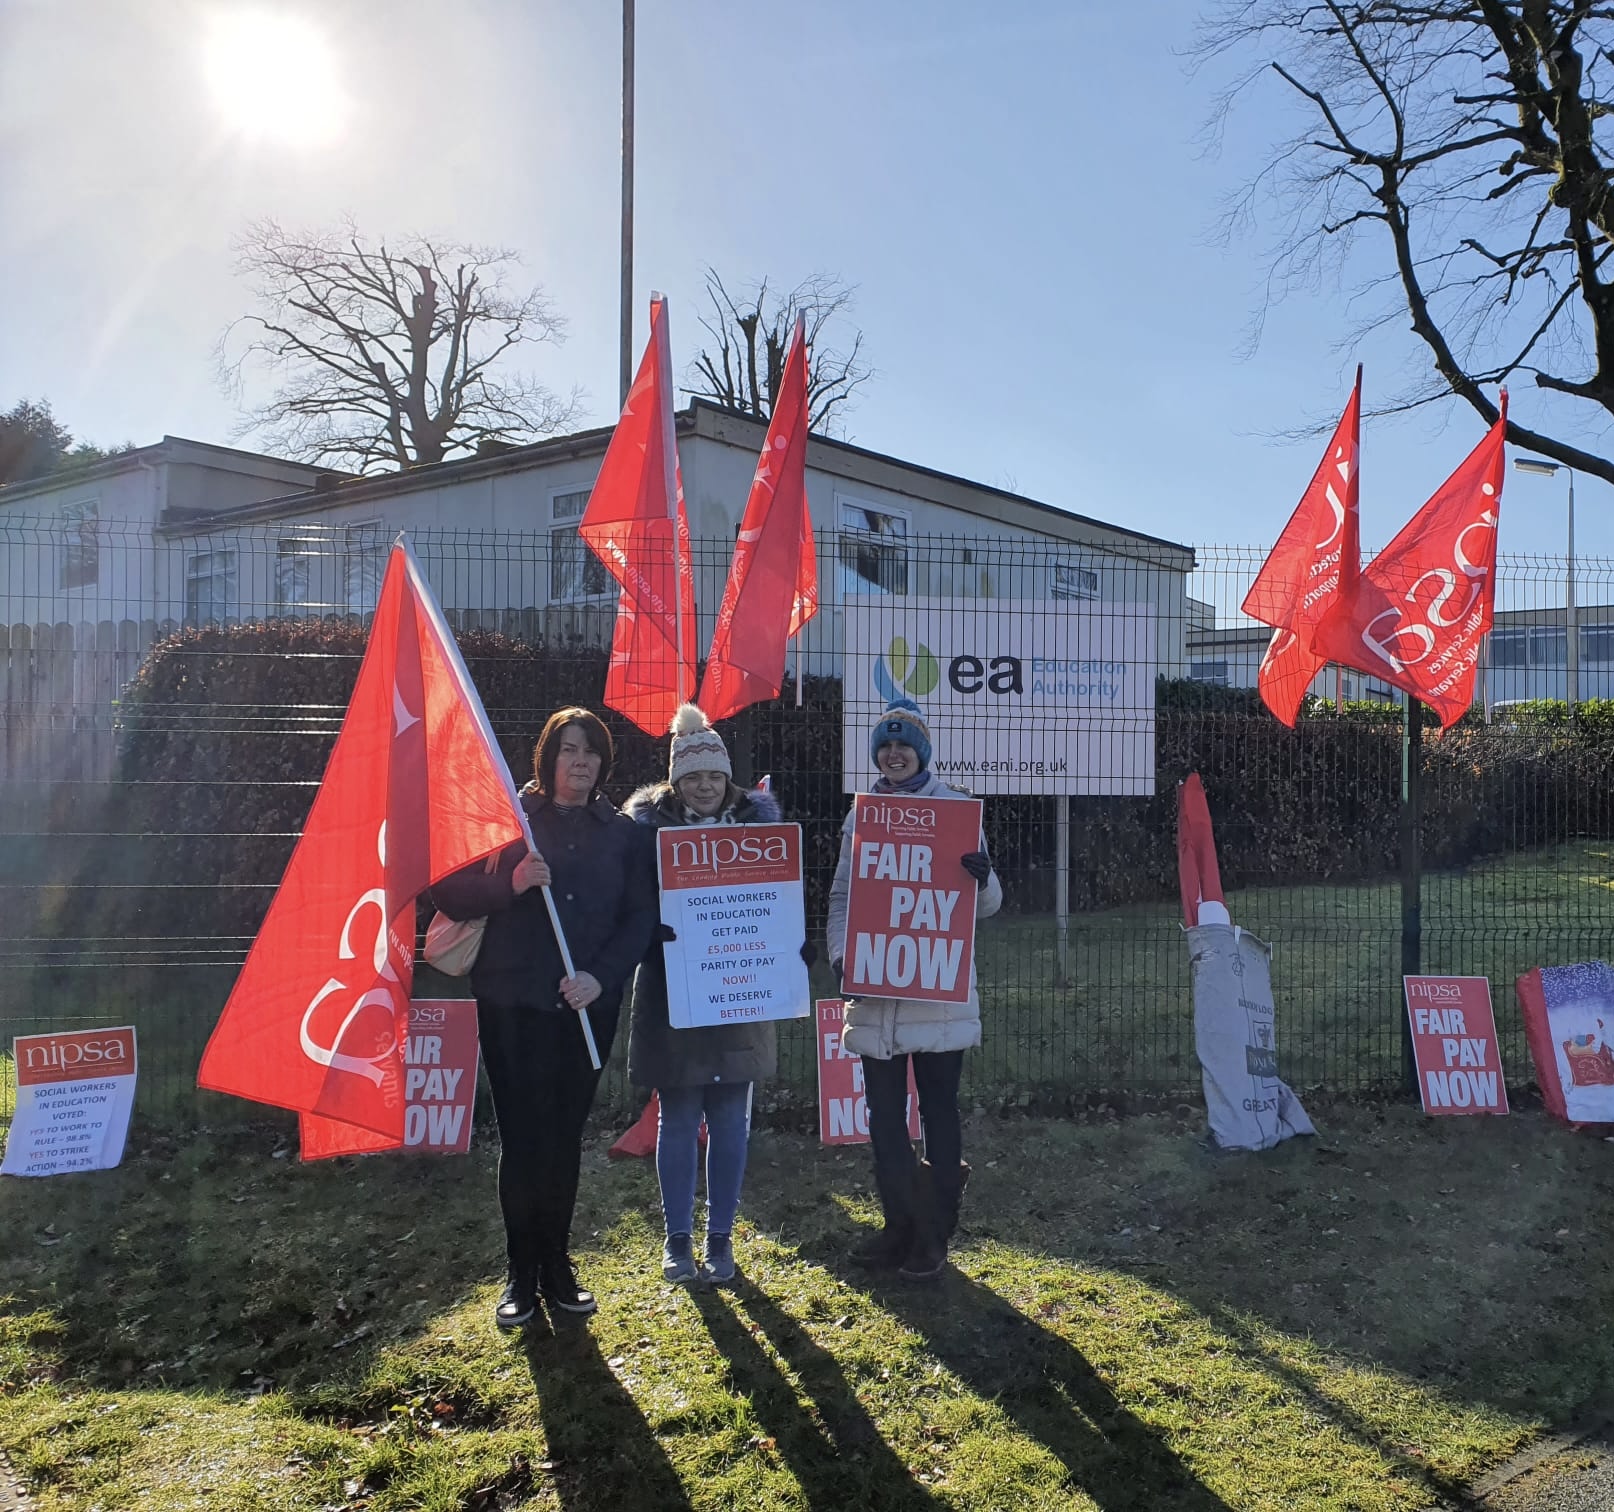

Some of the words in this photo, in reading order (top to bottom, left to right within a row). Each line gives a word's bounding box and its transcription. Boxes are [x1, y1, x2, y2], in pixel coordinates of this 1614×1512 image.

[948, 655, 1023, 695] ea
[1032, 679, 1119, 700] Authority
[935, 758, 1067, 775] www.eani.org.uk
[862, 802, 936, 834] nipsa
[672, 834, 788, 874] nipsa
[859, 841, 933, 883] FAIR
[687, 896, 724, 906] SOCIAL
[726, 892, 777, 904] WORKERS
[696, 912, 708, 921] IN
[711, 908, 771, 920] EDUCATION
[889, 887, 960, 932] PAY
[712, 927, 731, 937] GET
[734, 925, 758, 935] PAID
[707, 944, 741, 955] £5,000
[744, 941, 766, 951] LESS
[701, 960, 736, 971] PARITY
[739, 959, 753, 968] OF
[756, 957, 775, 966] PAY
[853, 932, 964, 991] NOW
[722, 974, 757, 985] NOW!!
[709, 994, 726, 1004] WE
[728, 990, 773, 1001] DESERVE
[1411, 981, 1462, 1002] nipsa
[720, 1008, 764, 1018] BETTER!!
[1414, 1008, 1466, 1034] FAIR
[26, 1039, 126, 1071] nipsa
[405, 1035, 442, 1064] AIR
[1442, 1038, 1487, 1066] PAY
[34, 1088, 67, 1098] SOCIAL
[70, 1082, 116, 1094] WORKERS
[405, 1069, 464, 1100] PAY
[1426, 1070, 1498, 1107] NOW
[39, 1102, 50, 1110] IN
[52, 1095, 107, 1108] EDUCATION
[1243, 1098, 1277, 1112] GREAT
[52, 1110, 87, 1120] VOTED:
[61, 1123, 88, 1131] WORK
[404, 1104, 466, 1145] OW
[34, 1137, 57, 1146] RULE
[30, 1151, 45, 1159] YES
[46, 1149, 57, 1157] TO
[60, 1146, 89, 1155] STRIKE
[26, 1162, 56, 1172] ACTION
